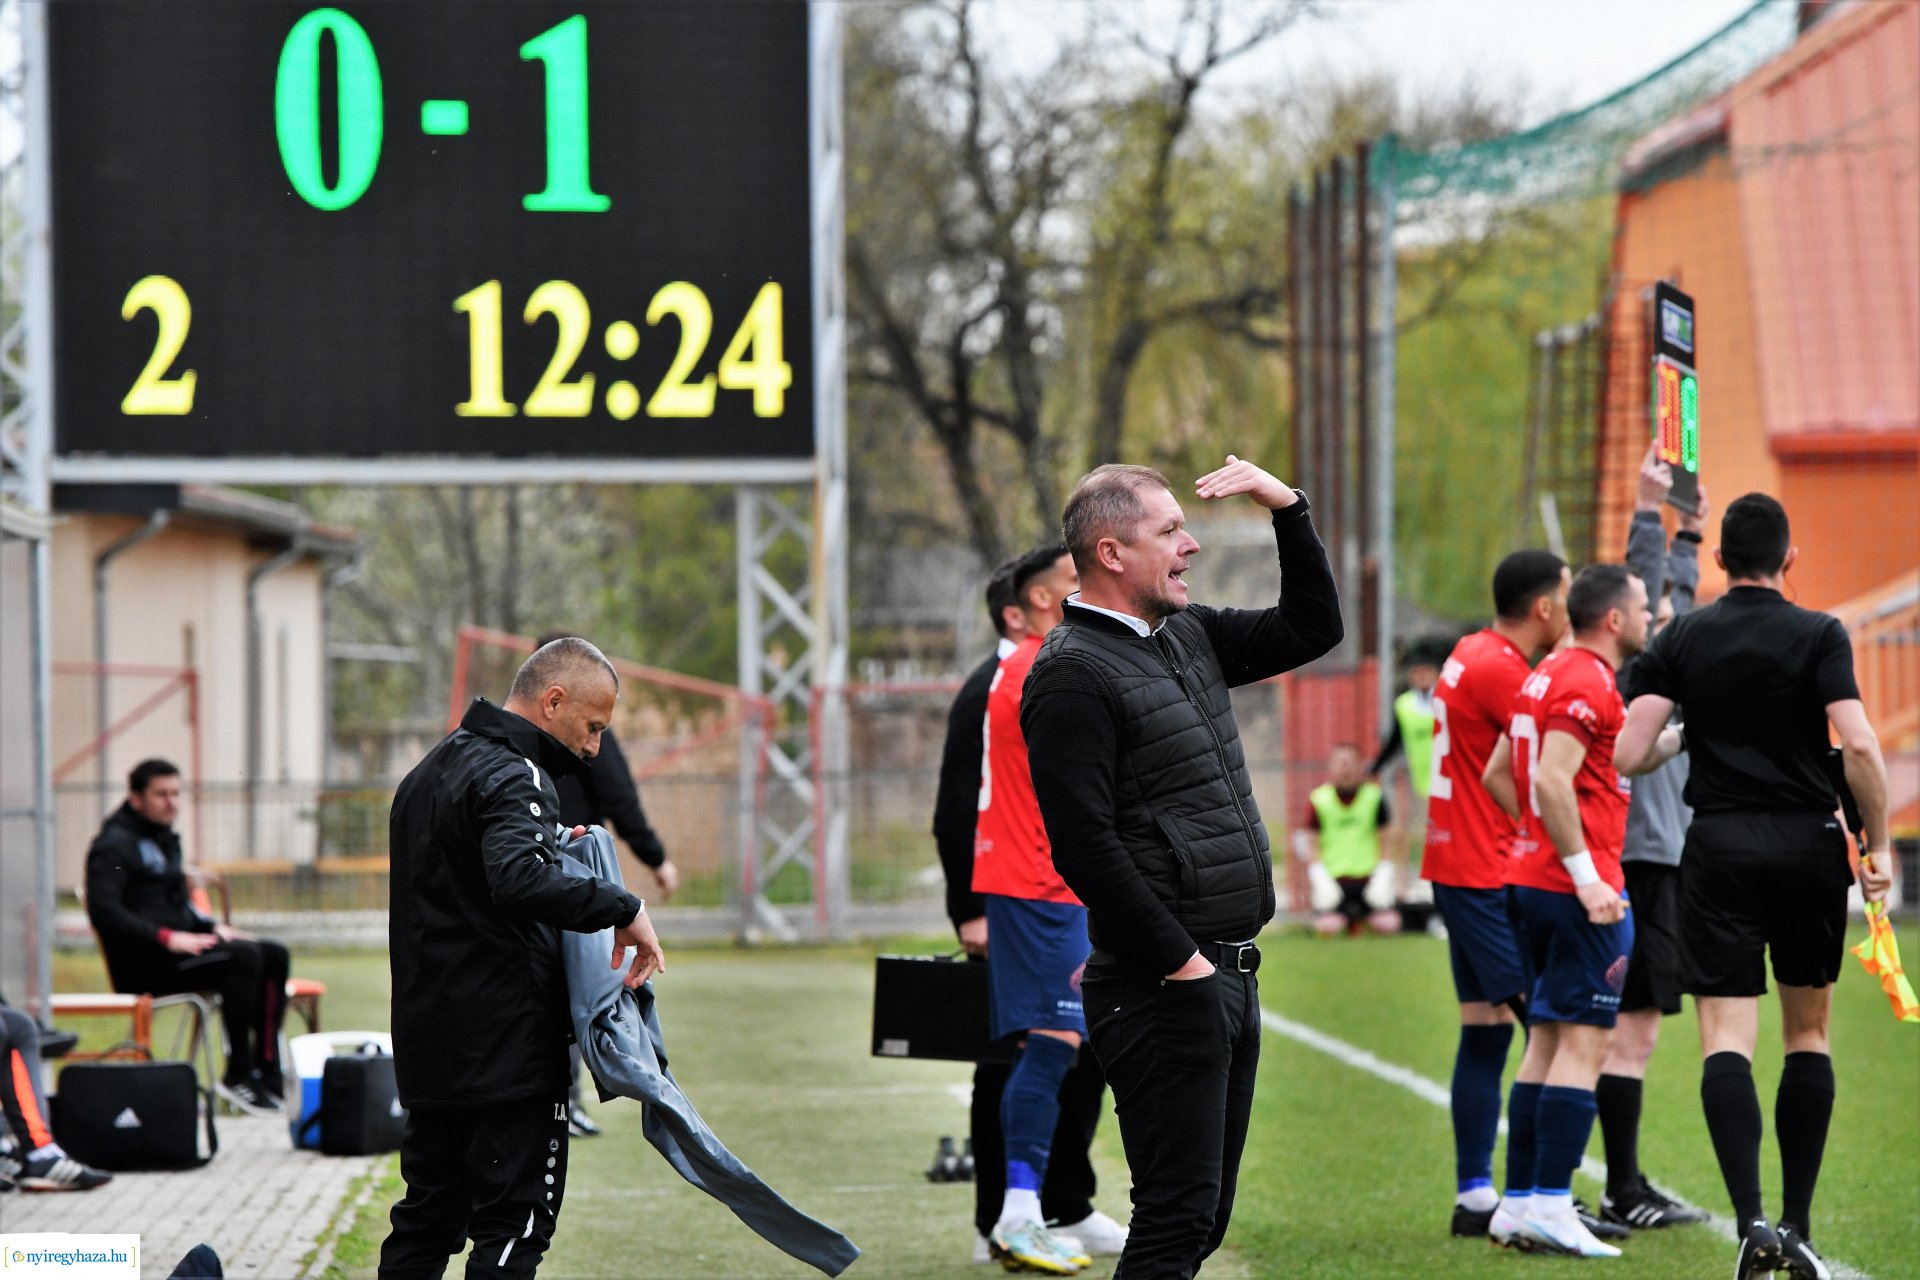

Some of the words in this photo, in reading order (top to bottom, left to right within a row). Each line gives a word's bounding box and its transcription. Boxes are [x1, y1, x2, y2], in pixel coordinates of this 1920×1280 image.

[275, 8, 384, 212] 0
[520, 14, 611, 213] 1
[121, 274, 198, 416] 2
[453, 279, 792, 421] 12:24
